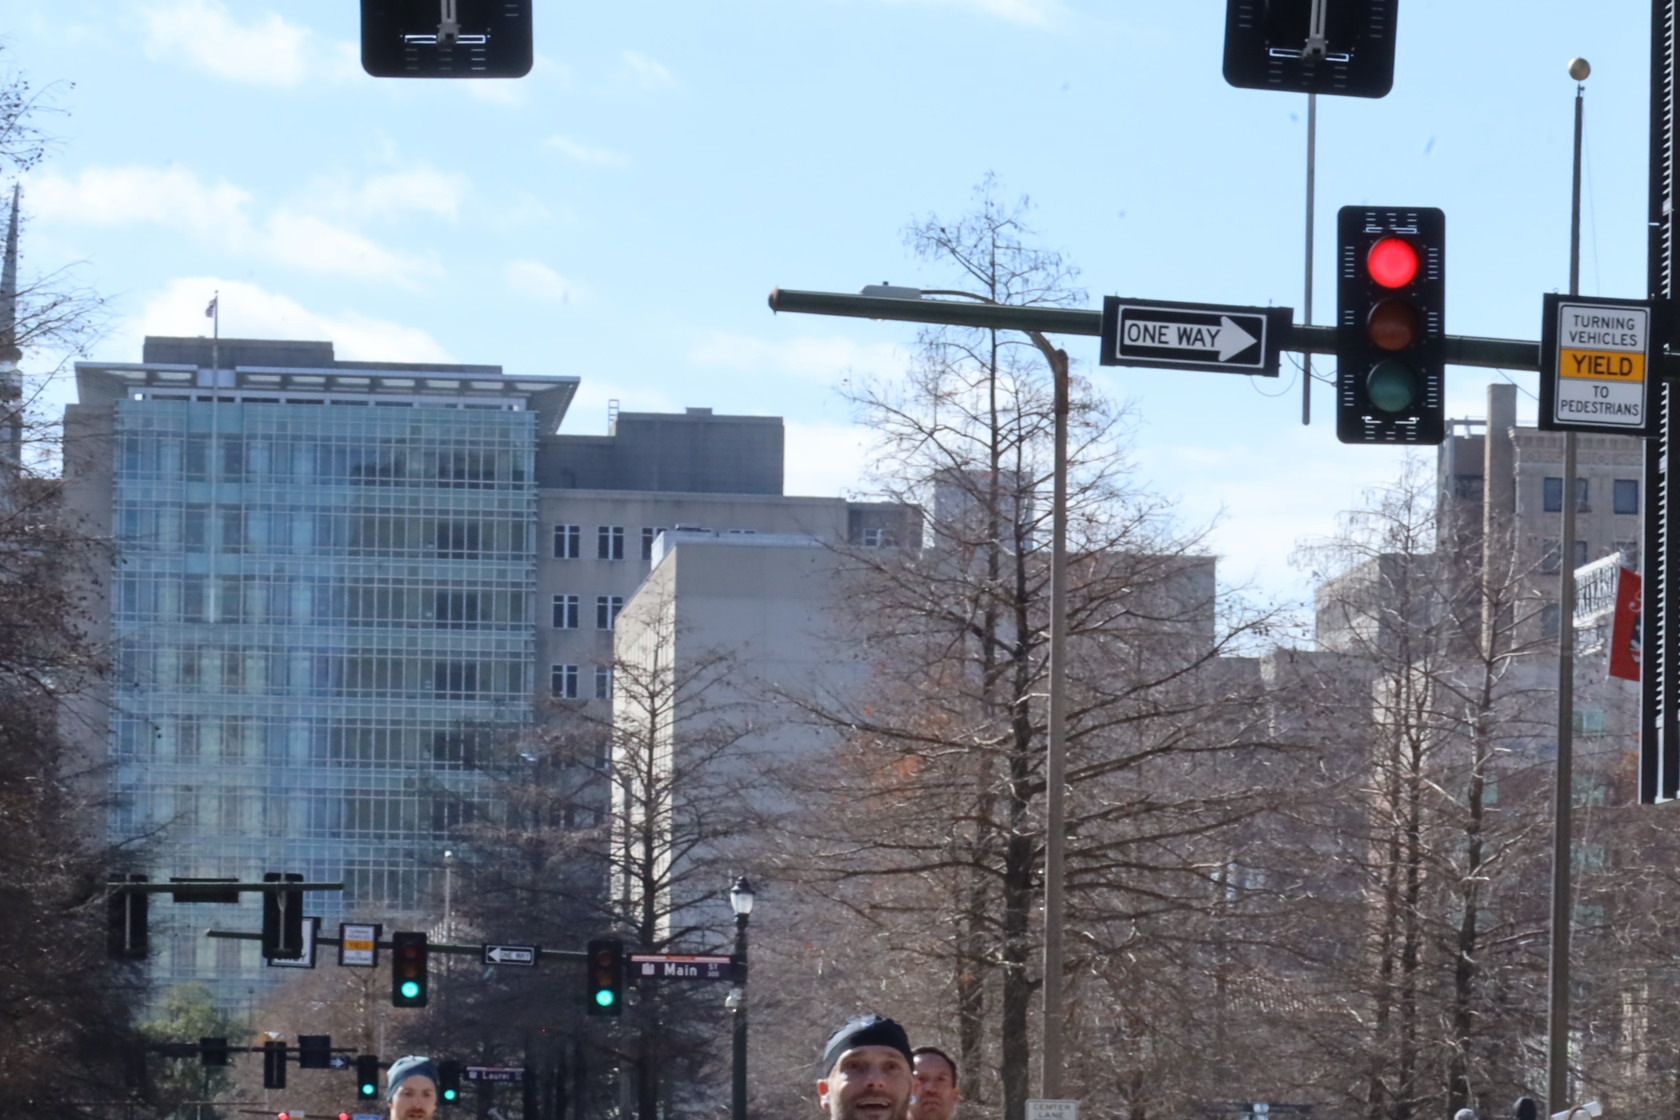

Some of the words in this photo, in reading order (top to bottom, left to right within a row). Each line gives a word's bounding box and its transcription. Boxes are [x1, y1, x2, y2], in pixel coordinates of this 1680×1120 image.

[1573, 315, 1635, 331] TURNING
[1127, 323, 1170, 345] ONE
[1177, 326, 1221, 348] WAY
[1569, 331, 1638, 347] VEHICLES
[1572, 354, 1633, 376] YIELD
[1592, 385, 1609, 399] TO
[1560, 400, 1640, 417] PEDESTRIANS
[664, 962, 698, 976] Main
[1033, 1103, 1071, 1111] CENTER
